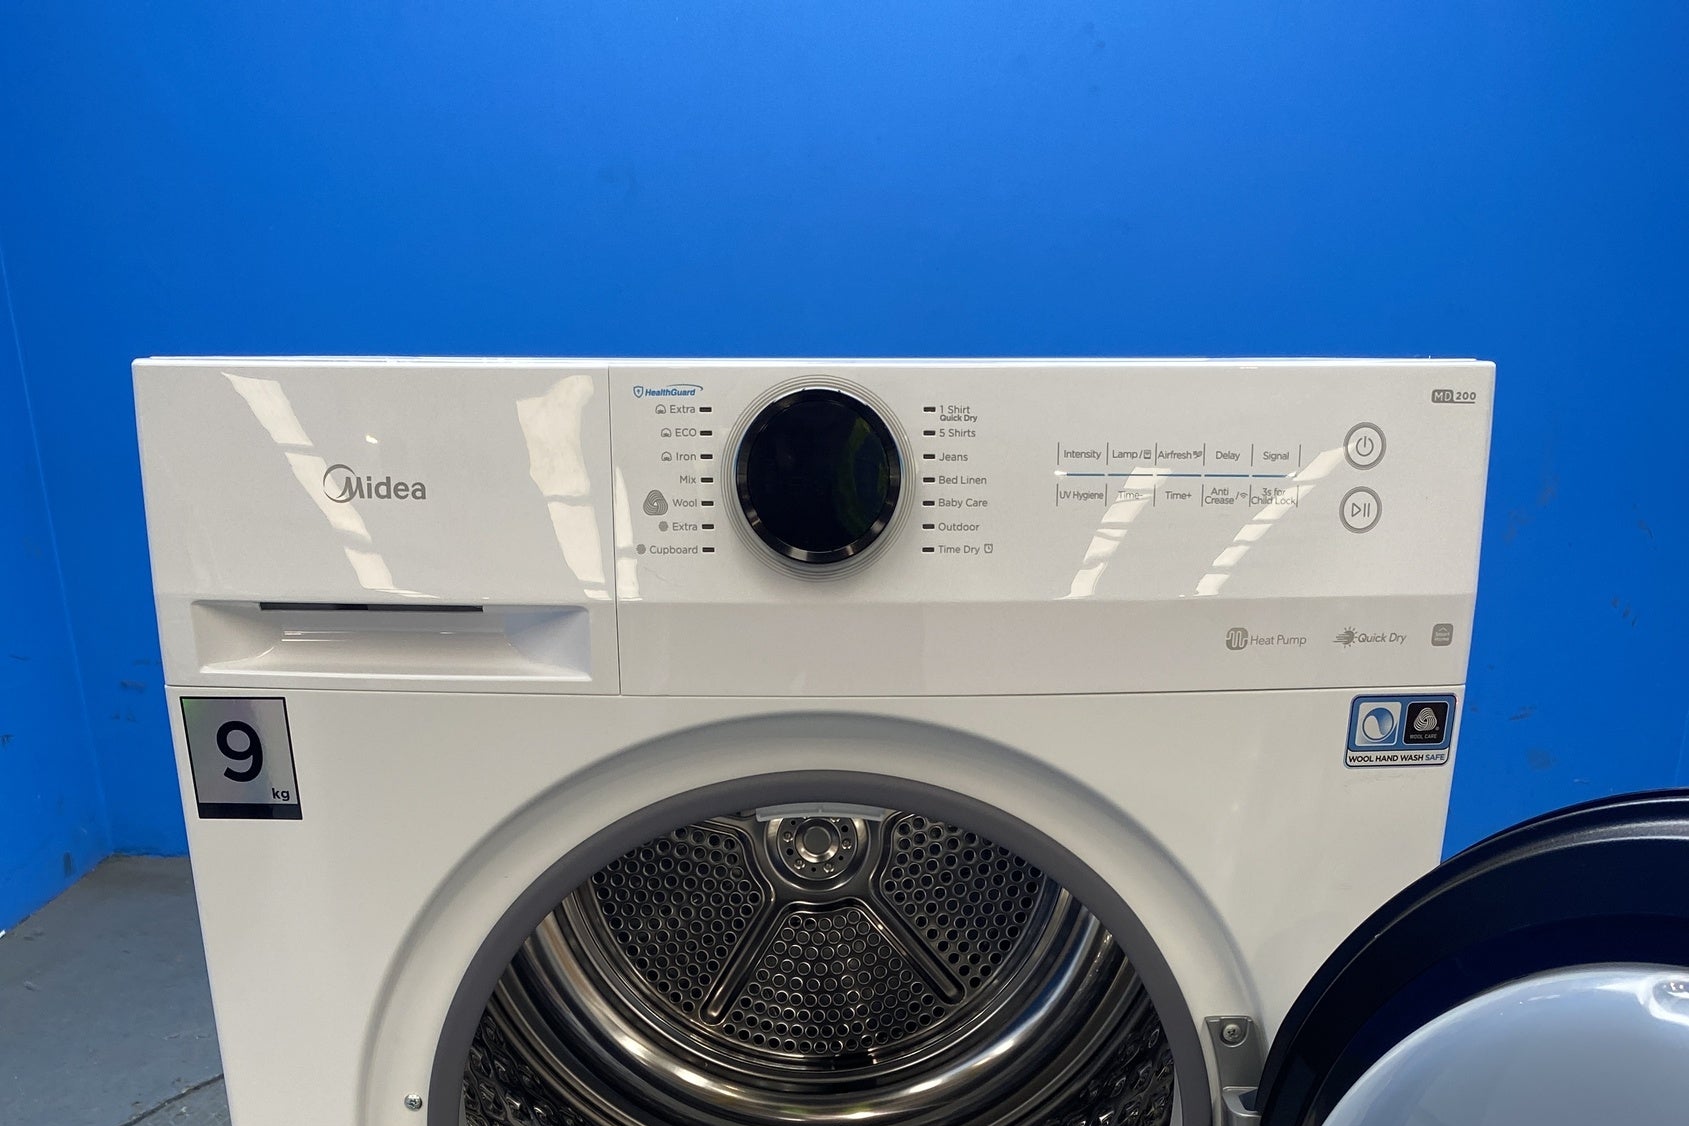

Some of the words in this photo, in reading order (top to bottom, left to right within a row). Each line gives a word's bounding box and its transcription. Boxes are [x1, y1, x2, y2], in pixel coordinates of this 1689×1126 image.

[645, 388, 696, 397] HealthGuard
[669, 404, 696, 414] Extra
[940, 406, 944, 414] 1
[947, 405, 971, 414] Shirt
[939, 414, 962, 422] Quick
[963, 414, 978, 423] Dry
[675, 428, 697, 437] ECO
[939, 429, 945, 437] 5
[948, 429, 976, 437] Shirts
[676, 452, 697, 461] Iron
[938, 453, 968, 462] Jeans
[1063, 449, 1102, 460] Intensity
[1157, 450, 1192, 460] Airfresh
[1215, 450, 1240, 462] Delay
[1262, 451, 1289, 461] Signal
[323, 463, 426, 503] Midea
[679, 475, 696, 484] Mix
[938, 475, 958, 485] Bed
[960, 475, 987, 485] Linen
[1059, 491, 1071, 499] UV
[1073, 490, 1104, 501] Hygiene
[1165, 491, 1192, 499] Time+
[1211, 487, 1229, 495] Anti
[1262, 487, 1272, 496] 3s
[672, 498, 697, 507] Wool
[938, 498, 962, 508] Baby
[965, 498, 988, 507] Care
[1204, 496, 1234, 504] Crease
[1251, 495, 1273, 505] Child
[672, 522, 698, 531] Extra
[938, 522, 980, 531] Outdoor
[650, 545, 698, 555] Cupboard
[938, 545, 961, 554] Time
[963, 545, 980, 555] Dry
[1250, 635, 1275, 646] Heat
[1276, 635, 1307, 646] Pump
[1358, 632, 1387, 643] Quick
[1389, 632, 1407, 644] Dry
[216, 720, 263, 783] 9
[1348, 755, 1374, 763] WOOL
[1400, 754, 1424, 762] WASH
[1425, 753, 1446, 761] SAFE
[271, 787, 290, 801] kg
